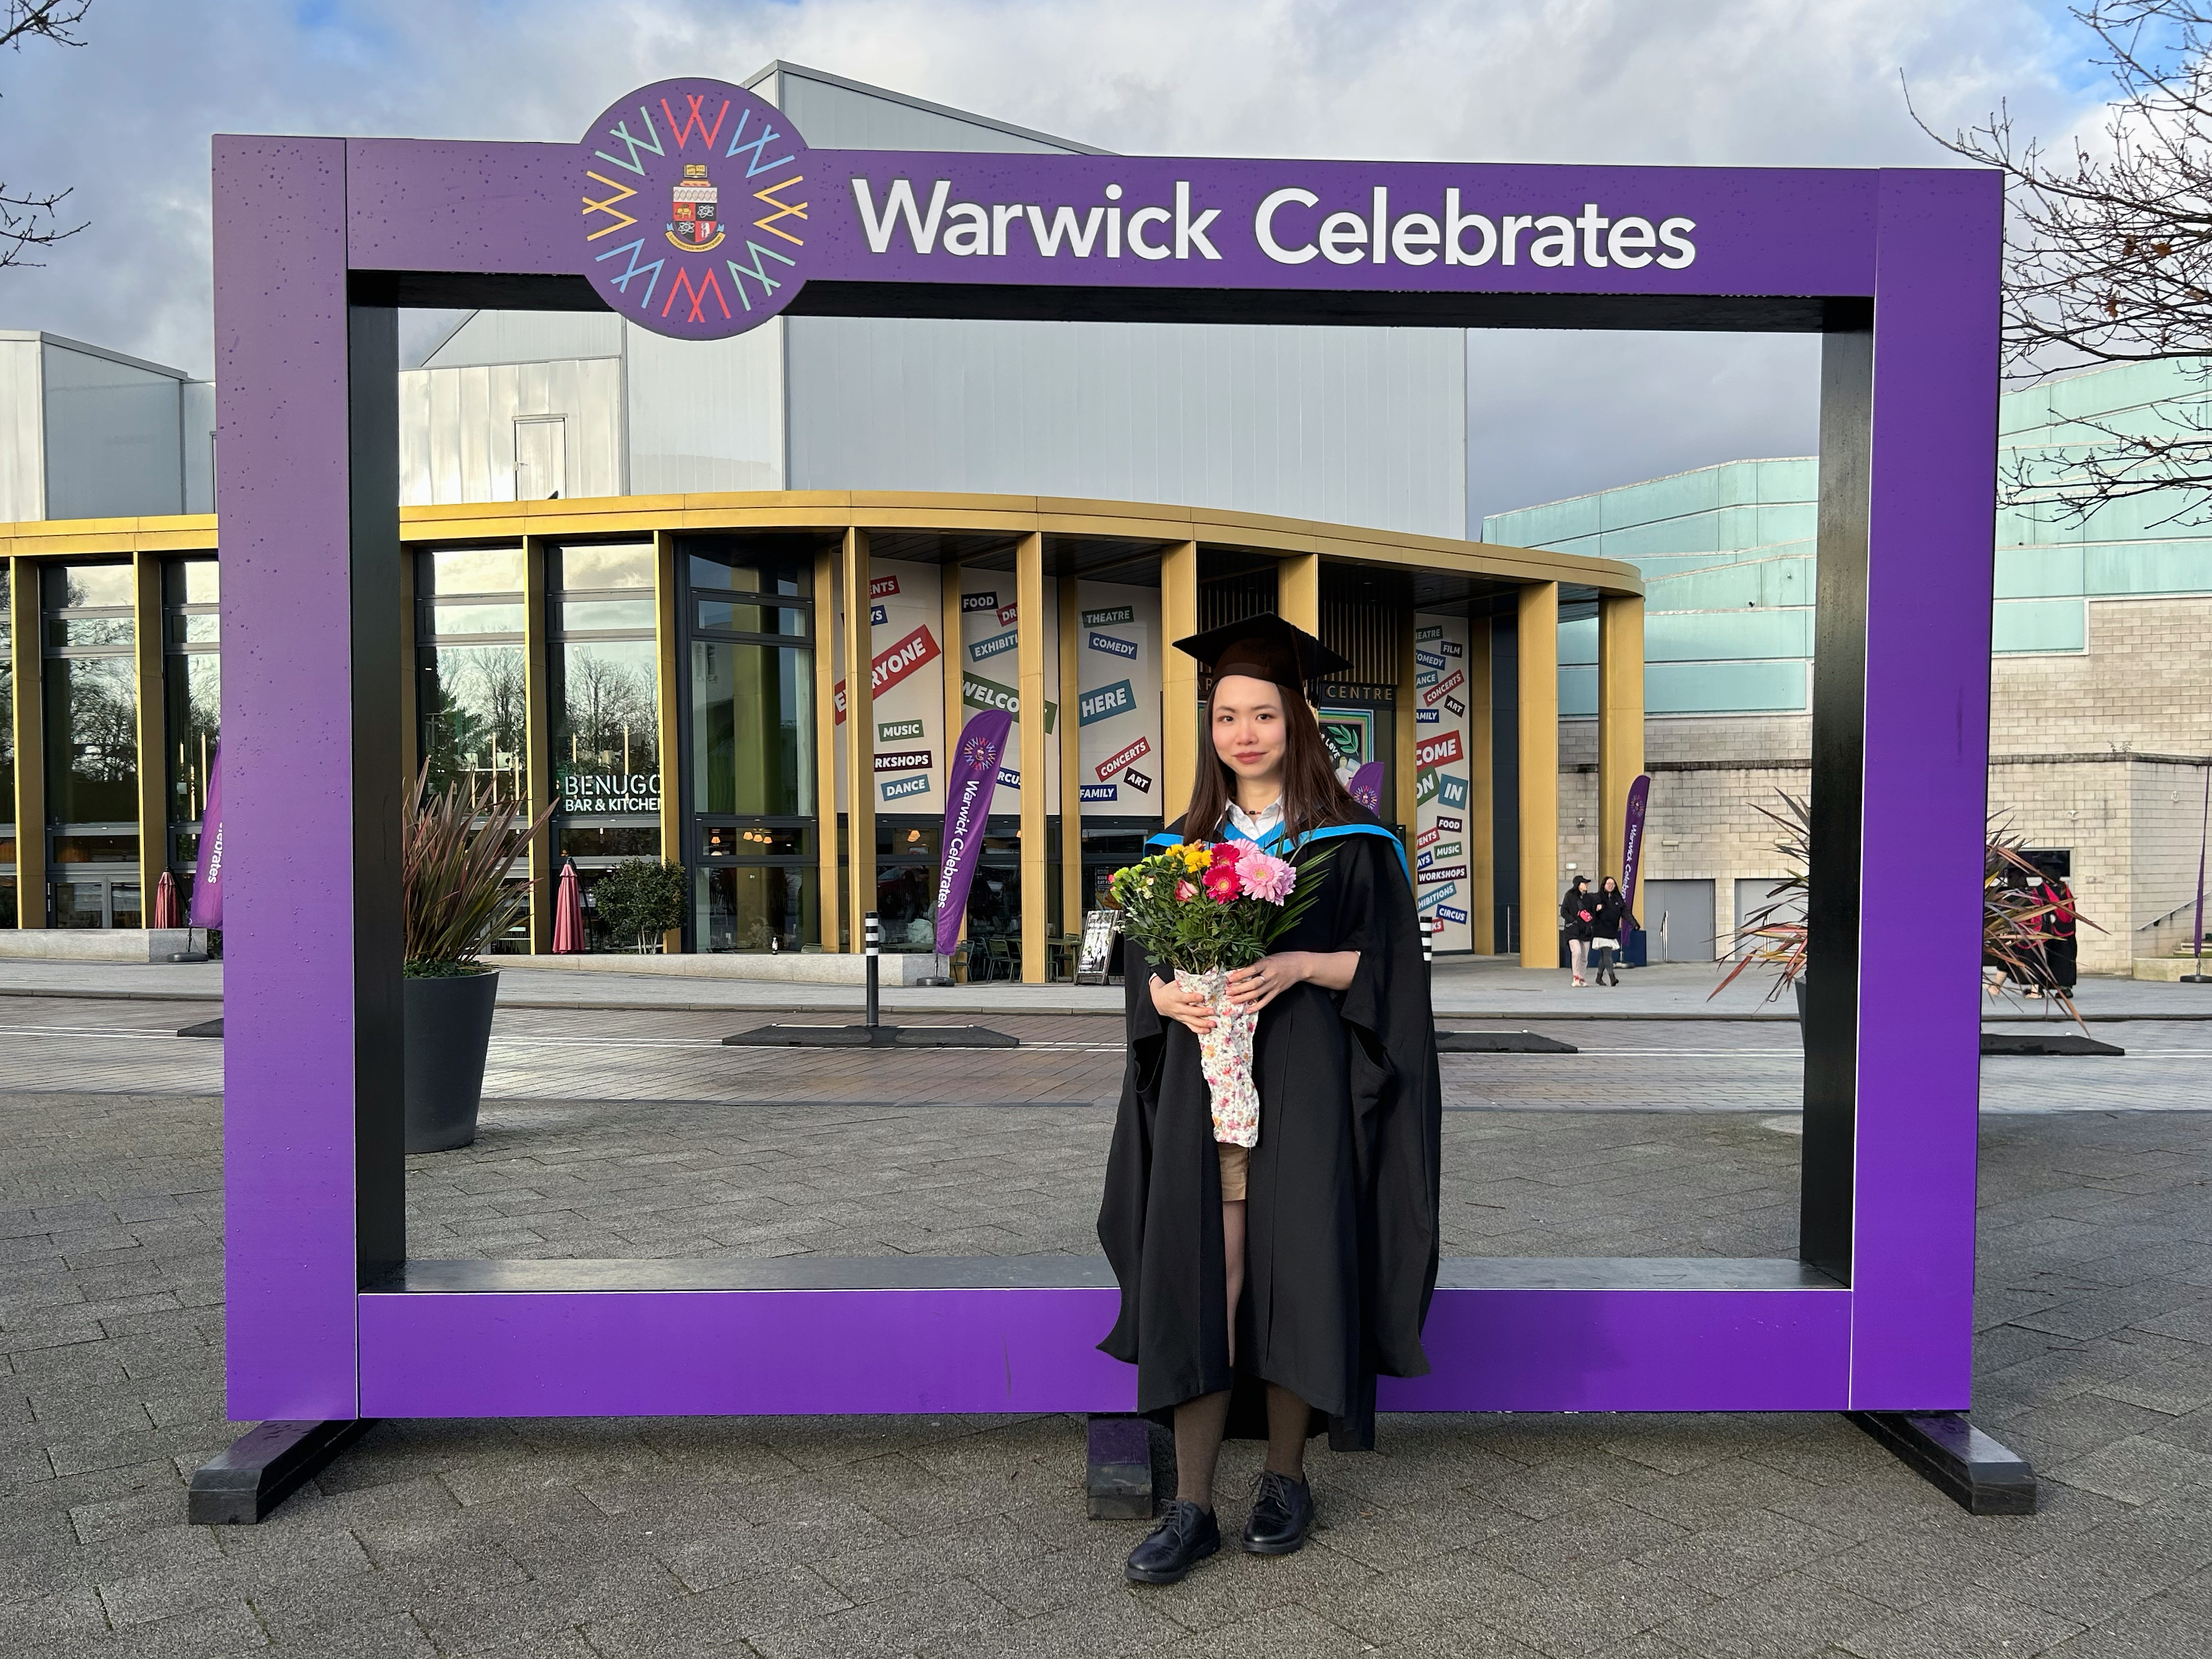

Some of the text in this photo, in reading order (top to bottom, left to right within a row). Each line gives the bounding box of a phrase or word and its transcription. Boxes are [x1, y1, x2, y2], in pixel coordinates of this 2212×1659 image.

[850, 178, 1697, 270] Warwick Celebrates
[963, 597, 994, 608] FOOD
[1086, 610, 1130, 624] THEATRE
[1093, 637, 1135, 655] COMEDY
[1443, 644, 1460, 654] FILM
[1327, 685, 1392, 700] CENTRE
[1427, 673, 1461, 702] CONCERTS
[1082, 687, 1126, 718] HERE
[1447, 700, 1463, 712] ART
[883, 724, 920, 738] MUSIC
[1325, 738, 1341, 759] LOVE
[874, 754, 928, 768] RKSHOPS
[1101, 741, 1146, 777] CONCERTS
[887, 778, 926, 796] DANCE
[1127, 773, 1148, 788] ART
[1080, 788, 1114, 798] FAMILY
[1444, 783, 1463, 802] IN
[565, 799, 592, 811] BAR
[595, 798, 606, 811] &
[1438, 819, 1460, 830] FOOD
[938, 779, 980, 909] Warwick Celebrates
[1626, 824, 1637, 862] Warwick
[1437, 845, 1459, 856] MUSIC
[1419, 869, 1465, 882] WORKSHOPS
[1439, 908, 1465, 921] CIRCUS
